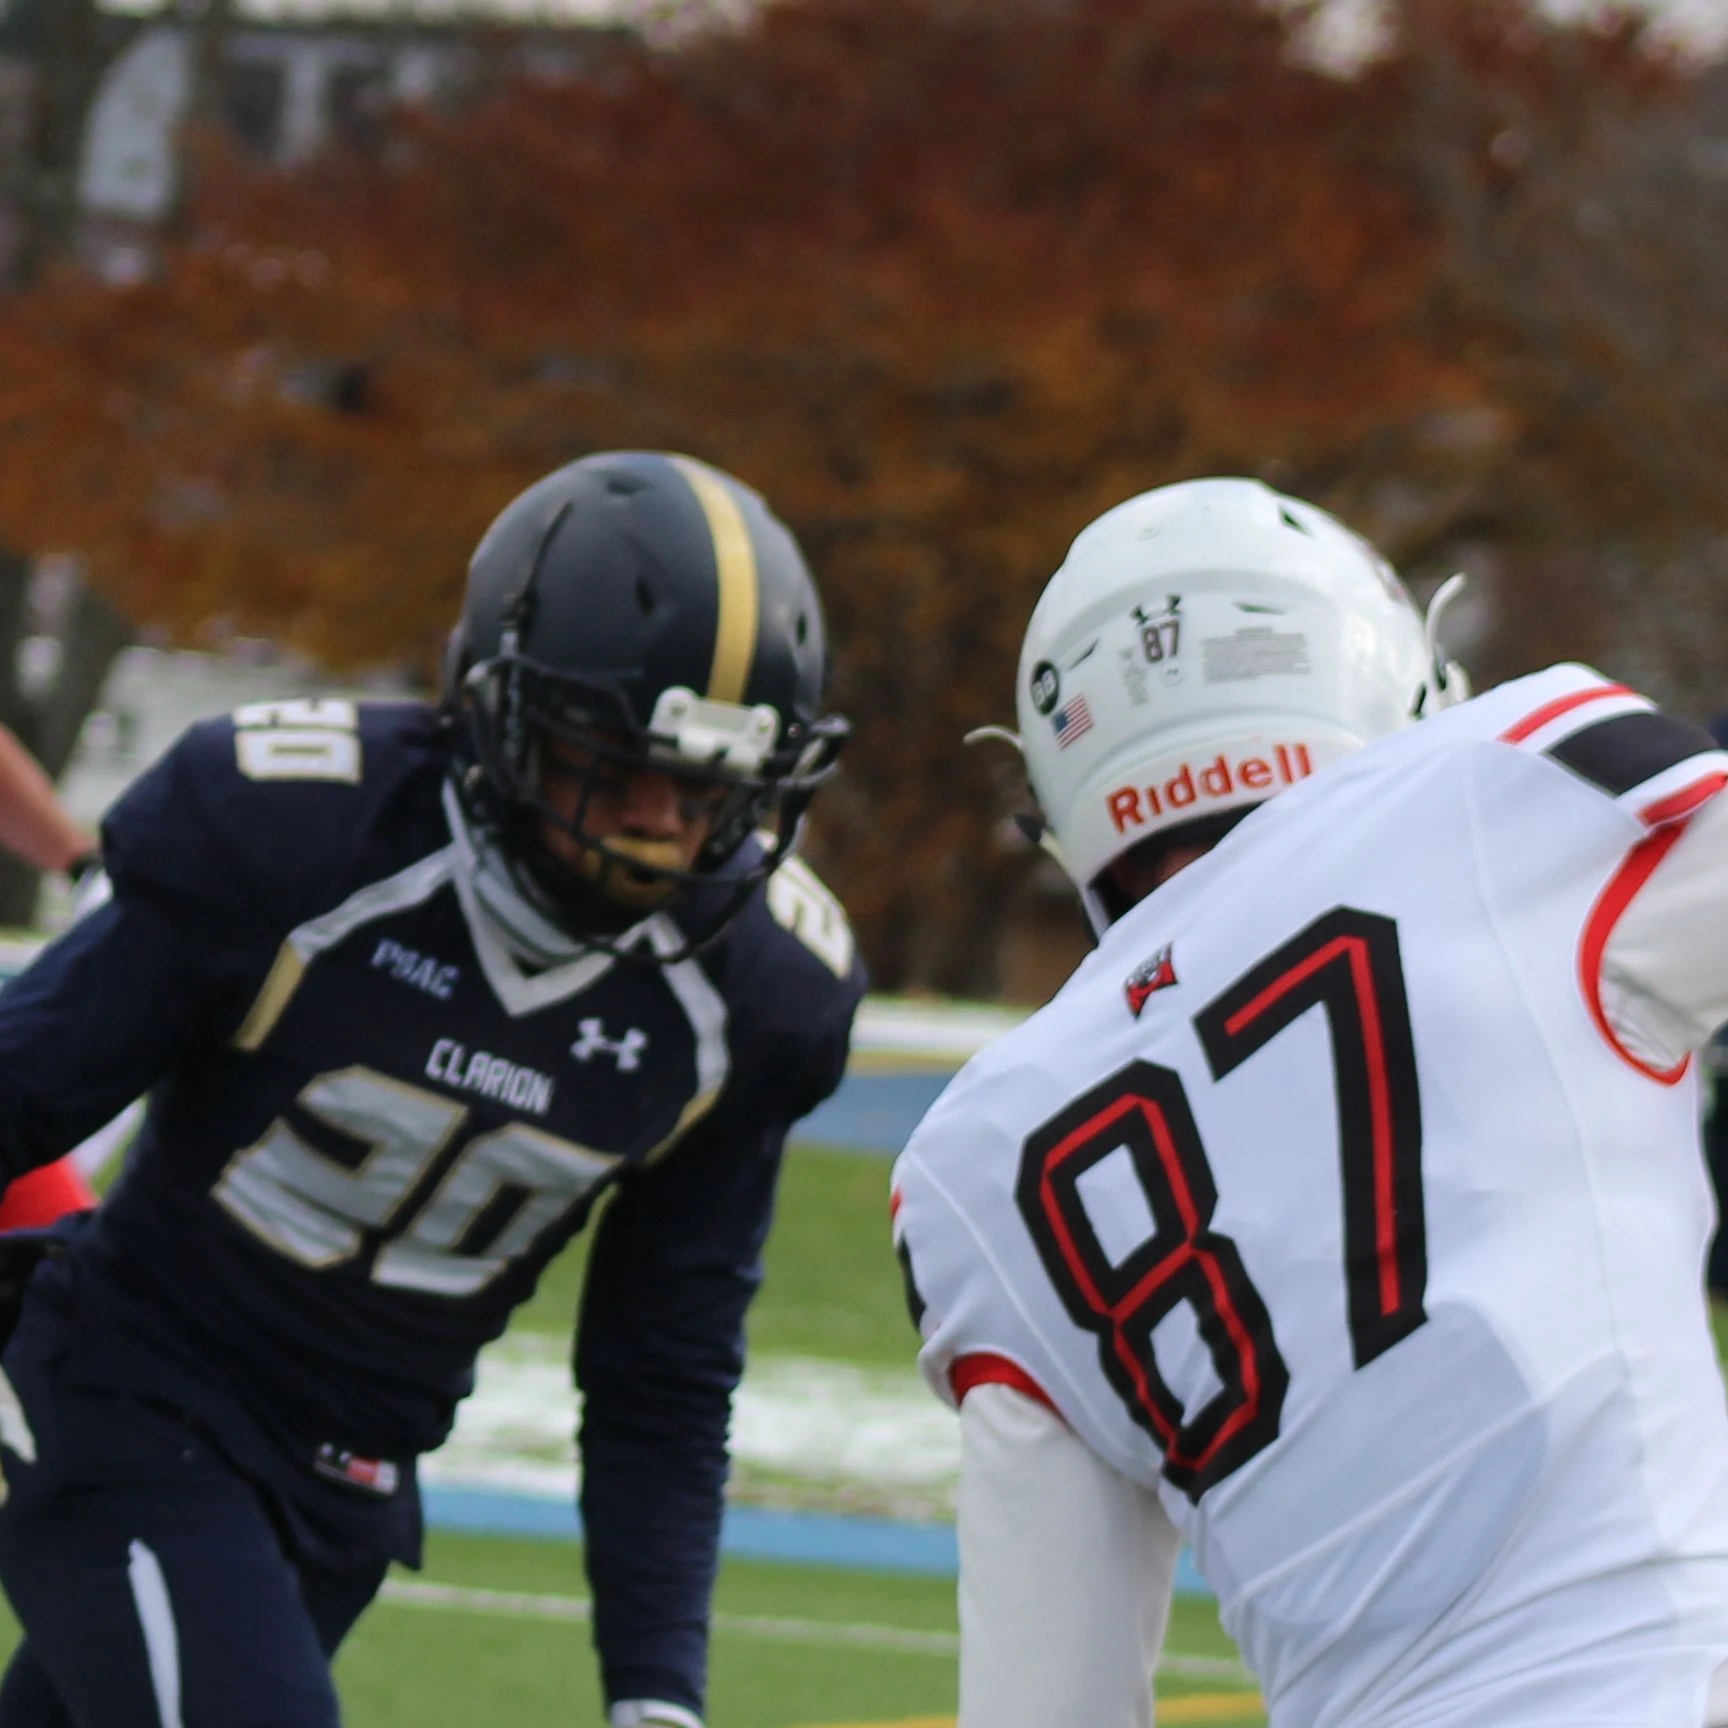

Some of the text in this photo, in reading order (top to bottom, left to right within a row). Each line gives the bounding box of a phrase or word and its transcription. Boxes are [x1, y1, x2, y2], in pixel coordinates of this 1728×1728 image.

[1140, 619, 1180, 664] 87
[1106, 743, 1316, 834] Riddell
[370, 937, 461, 1001] PSAC
[424, 1038, 556, 1118] CLARION
[213, 1064, 626, 1297] 20
[1016, 905, 1430, 1506] 87
